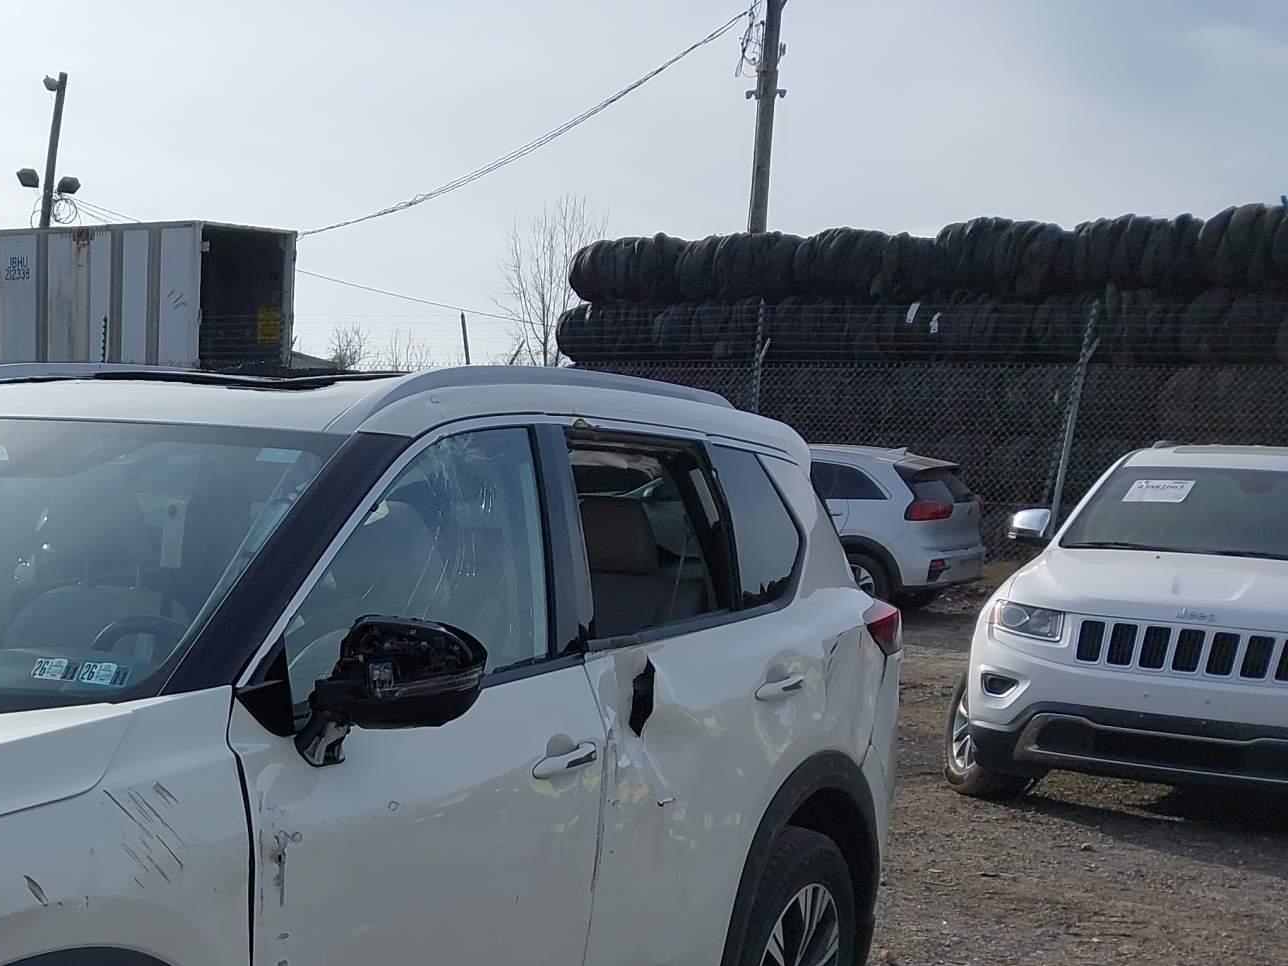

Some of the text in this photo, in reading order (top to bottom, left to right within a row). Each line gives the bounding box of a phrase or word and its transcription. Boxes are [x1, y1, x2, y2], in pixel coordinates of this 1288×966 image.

[7, 255, 29, 269] JBHU
[1175, 607, 1216, 623] Jeep
[32, 660, 50, 677] 26
[80, 663, 98, 681] 26
